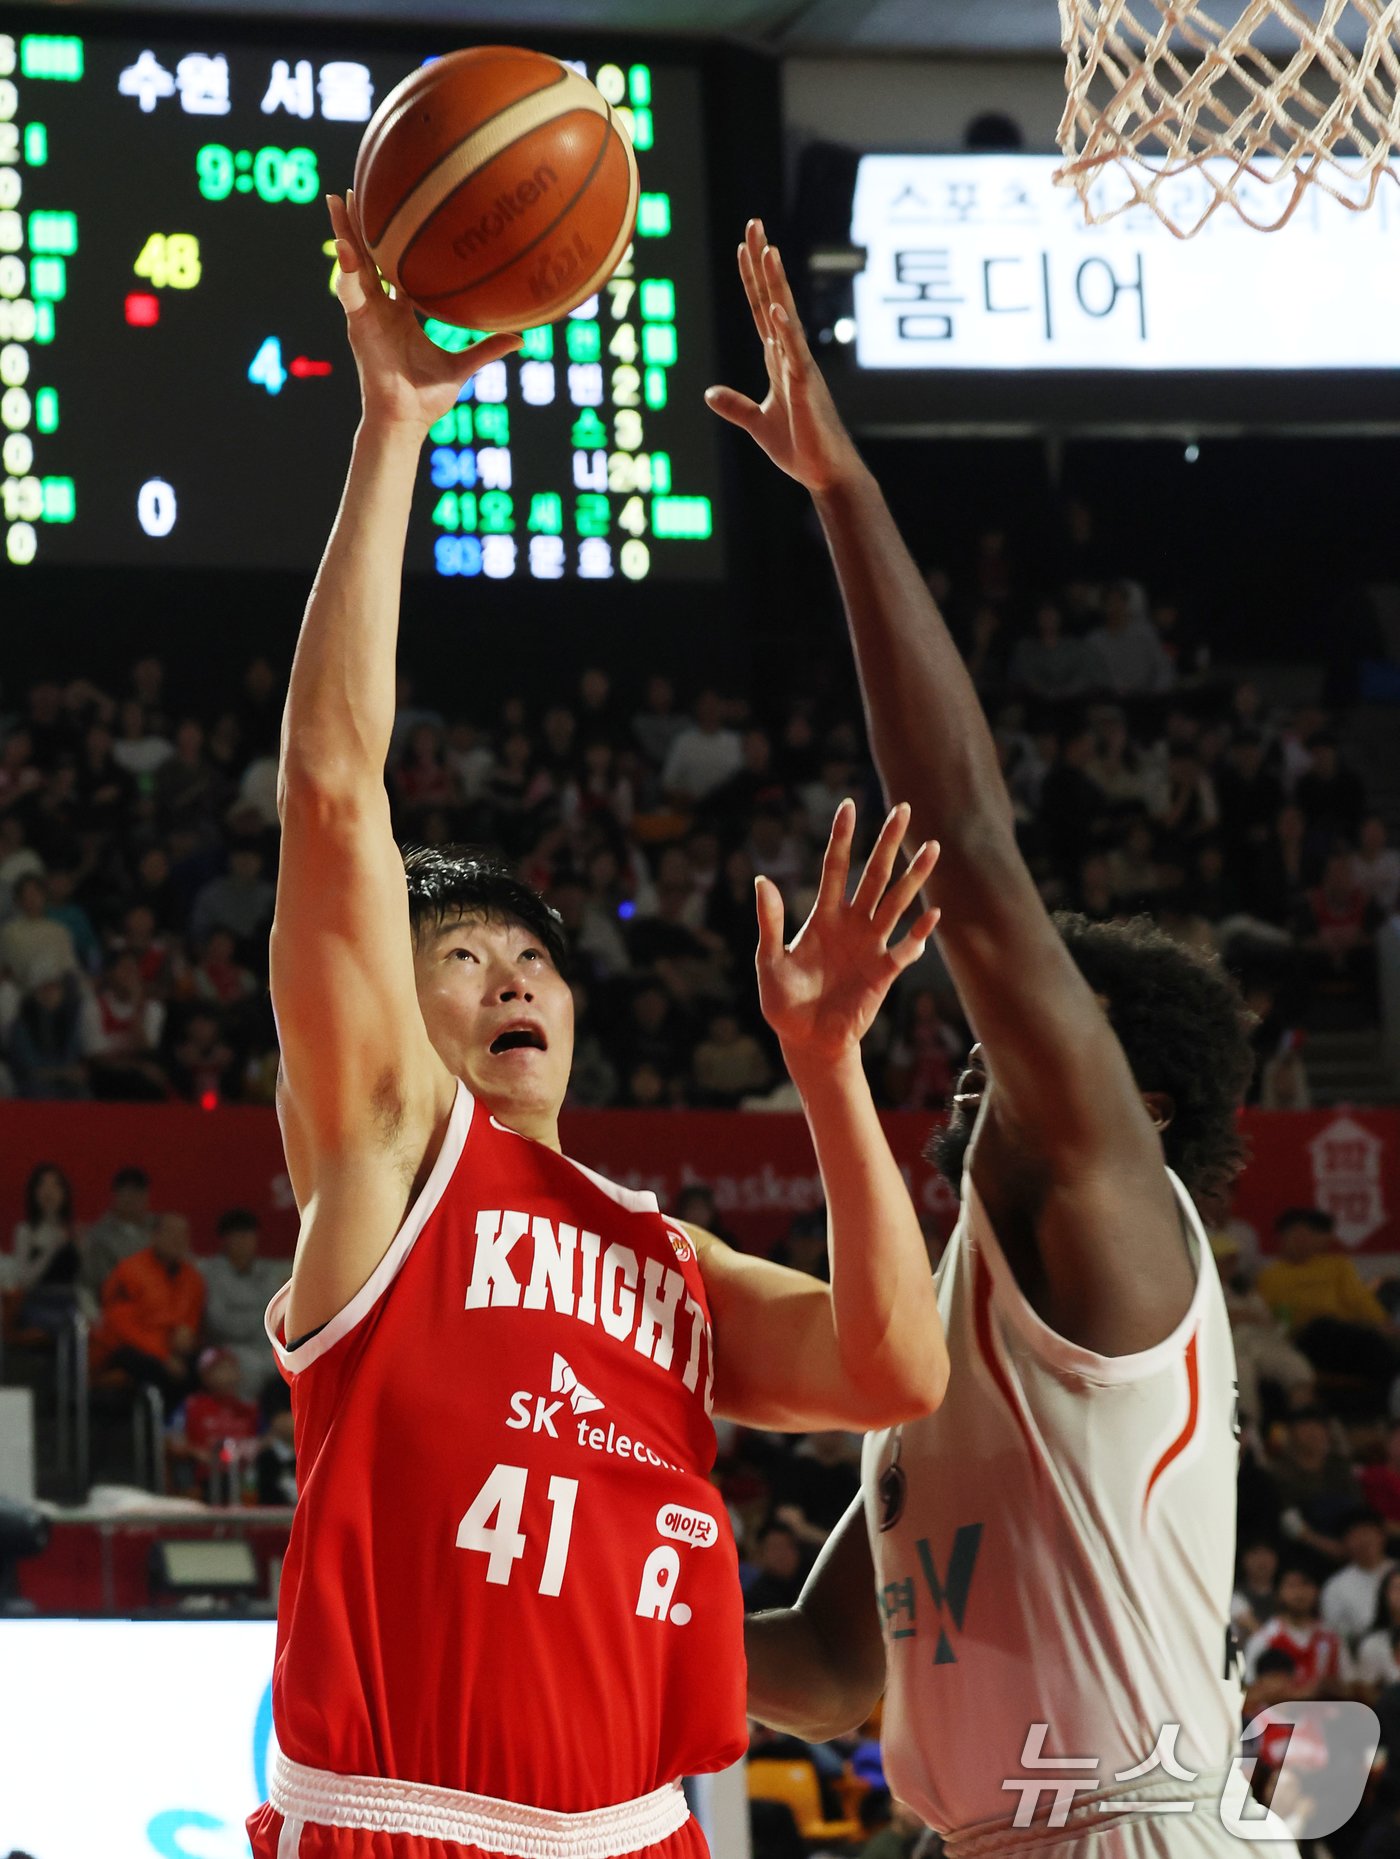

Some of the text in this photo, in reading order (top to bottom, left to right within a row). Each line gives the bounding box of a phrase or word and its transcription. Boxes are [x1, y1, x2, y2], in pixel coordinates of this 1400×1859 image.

[118, 49, 374, 122] 수원 서울
[196, 143, 320, 204] 9:06
[452, 161, 559, 262] molten
[134, 232, 202, 289] 48
[606, 278, 637, 321] 7
[882, 249, 1150, 341] 톰디어
[0, 343, 29, 387] 0
[248, 335, 288, 396] 4
[608, 322, 640, 364] 4
[1, 386, 31, 431] 0
[611, 363, 641, 408] 2
[613, 408, 644, 451] 3
[3, 432, 33, 477] 0
[137, 476, 177, 537] 0
[432, 490, 477, 533] 41
[618, 495, 649, 538] 4
[6, 521, 38, 566] 0
[620, 538, 650, 581] 0
[505, 1390, 564, 1439] SK
[455, 1463, 580, 1598] 41
[664, 1511, 713, 1543] 에이닷
